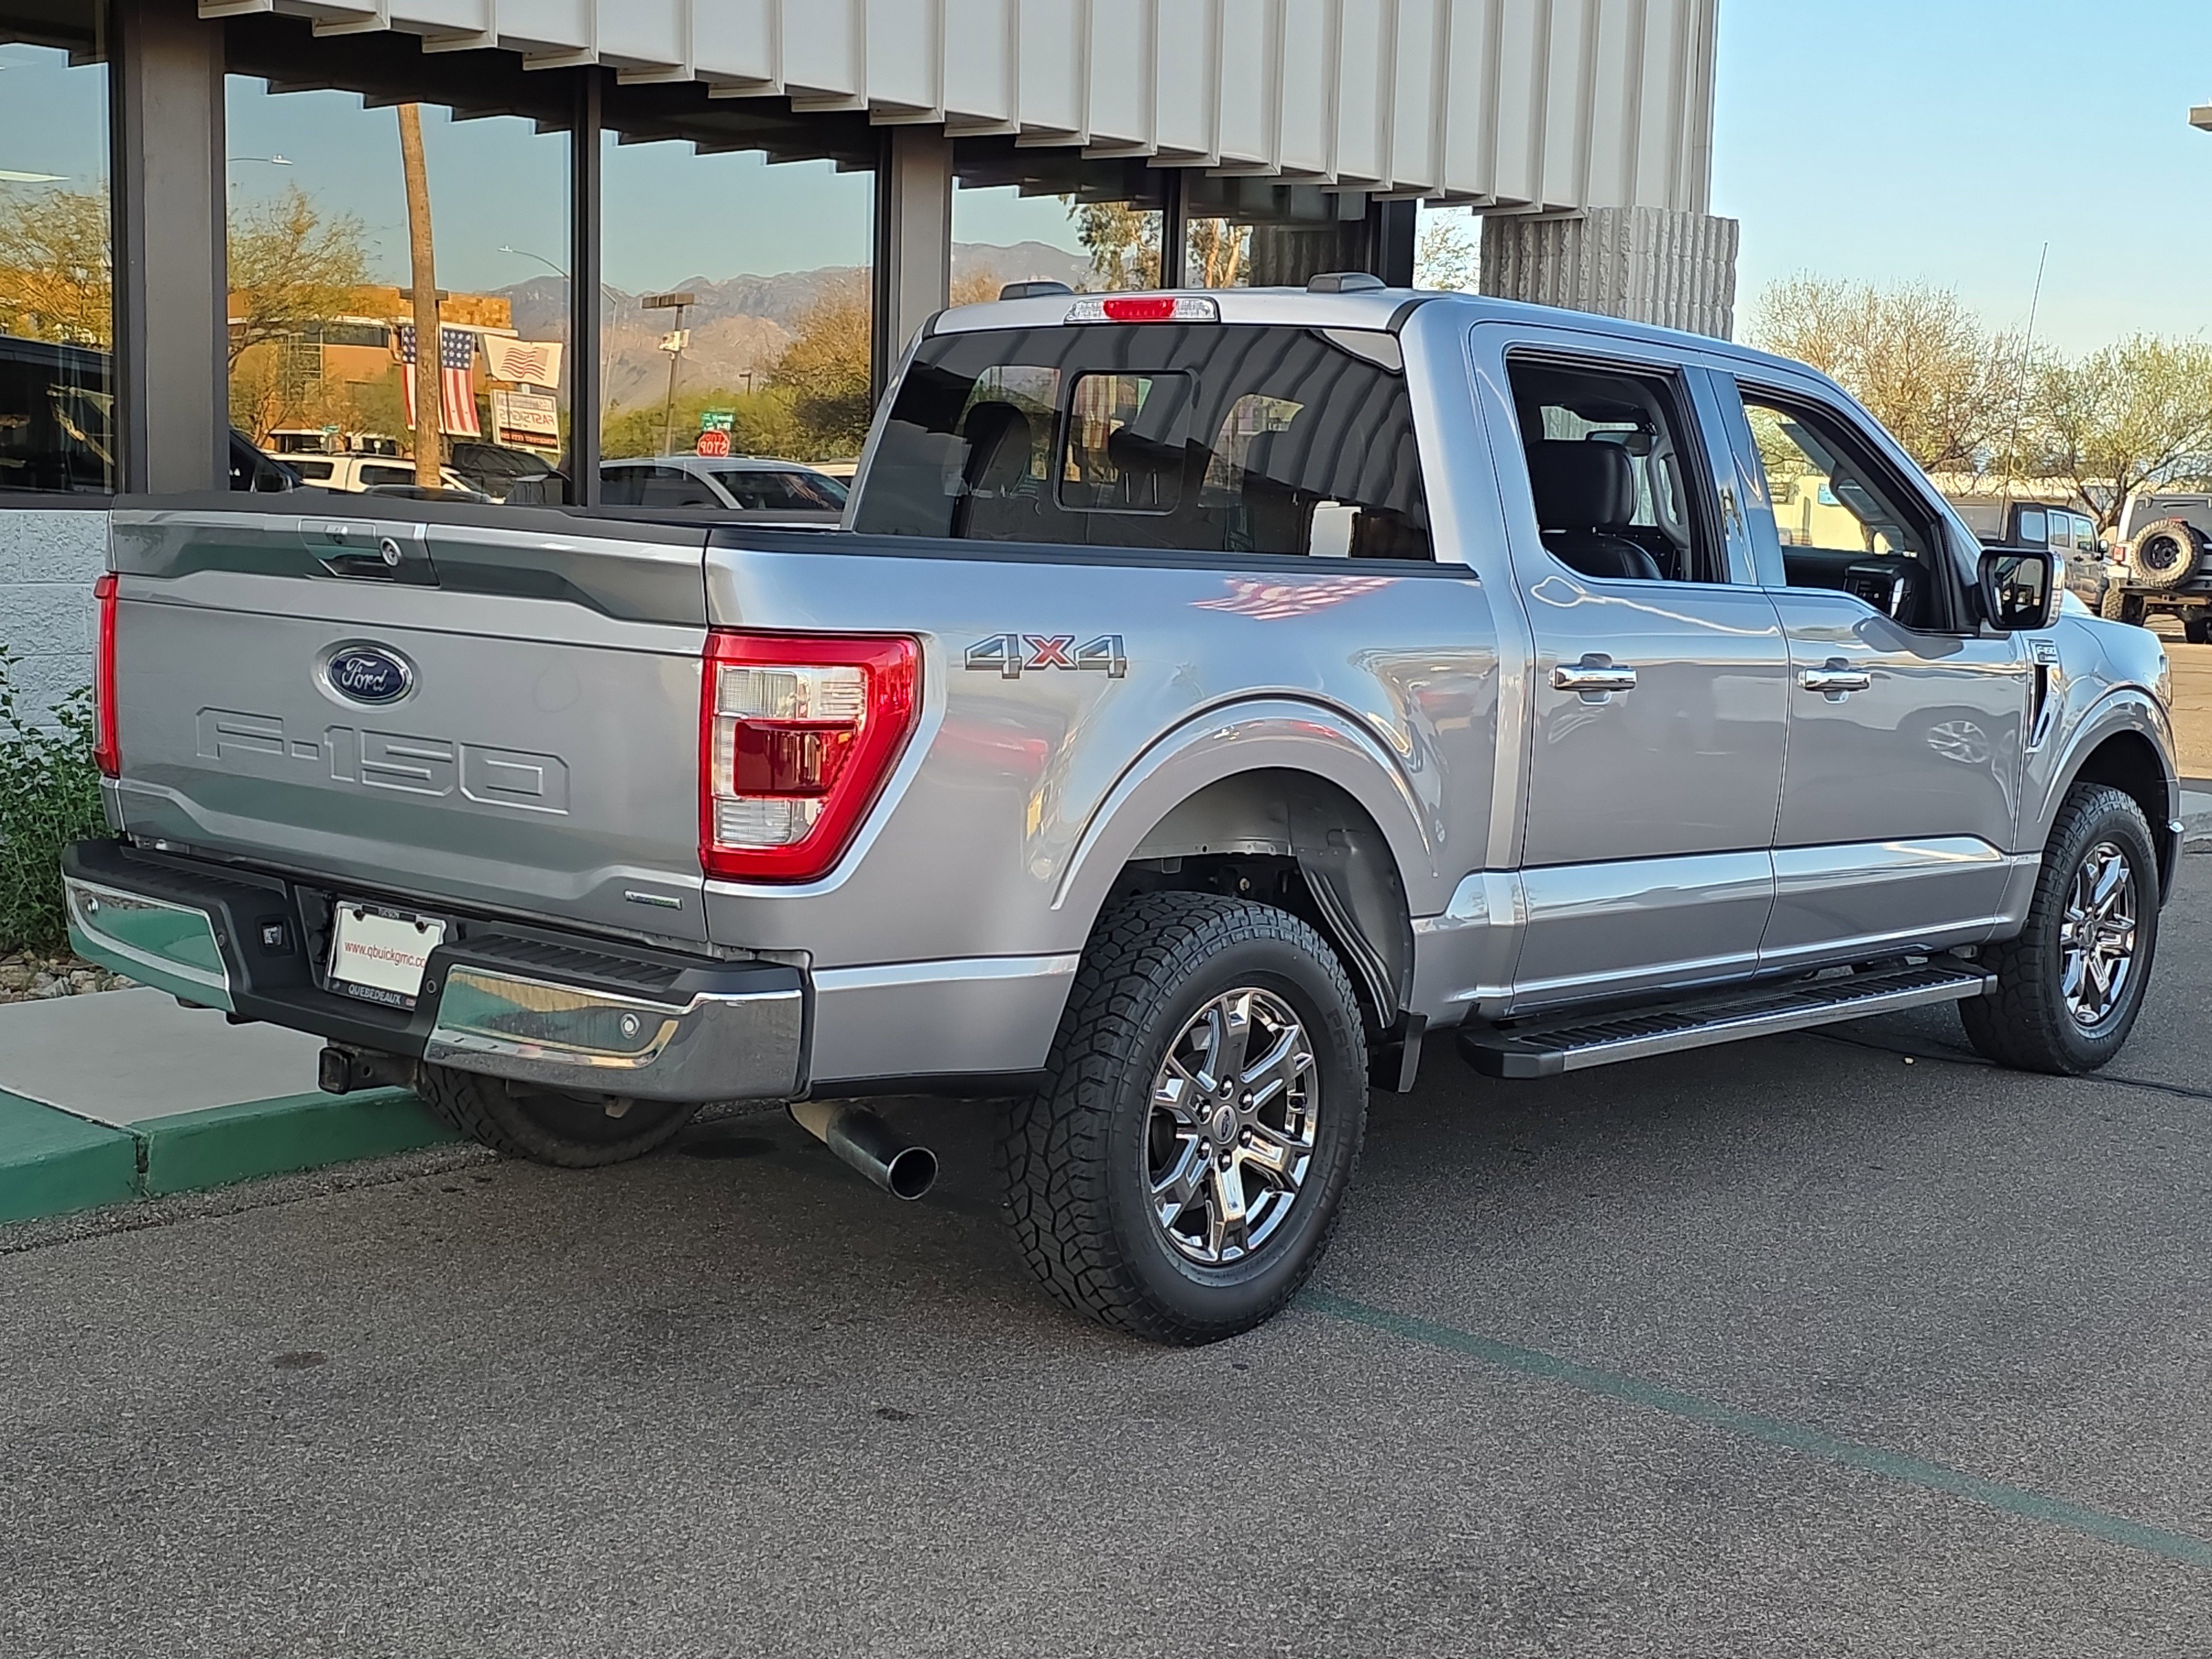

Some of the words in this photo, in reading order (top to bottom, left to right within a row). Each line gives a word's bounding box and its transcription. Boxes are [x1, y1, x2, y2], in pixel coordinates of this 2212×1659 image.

[342, 658, 389, 692] Ford
[196, 706, 570, 815] F-150
[348, 984, 402, 1005] QUEBEDEAUX
